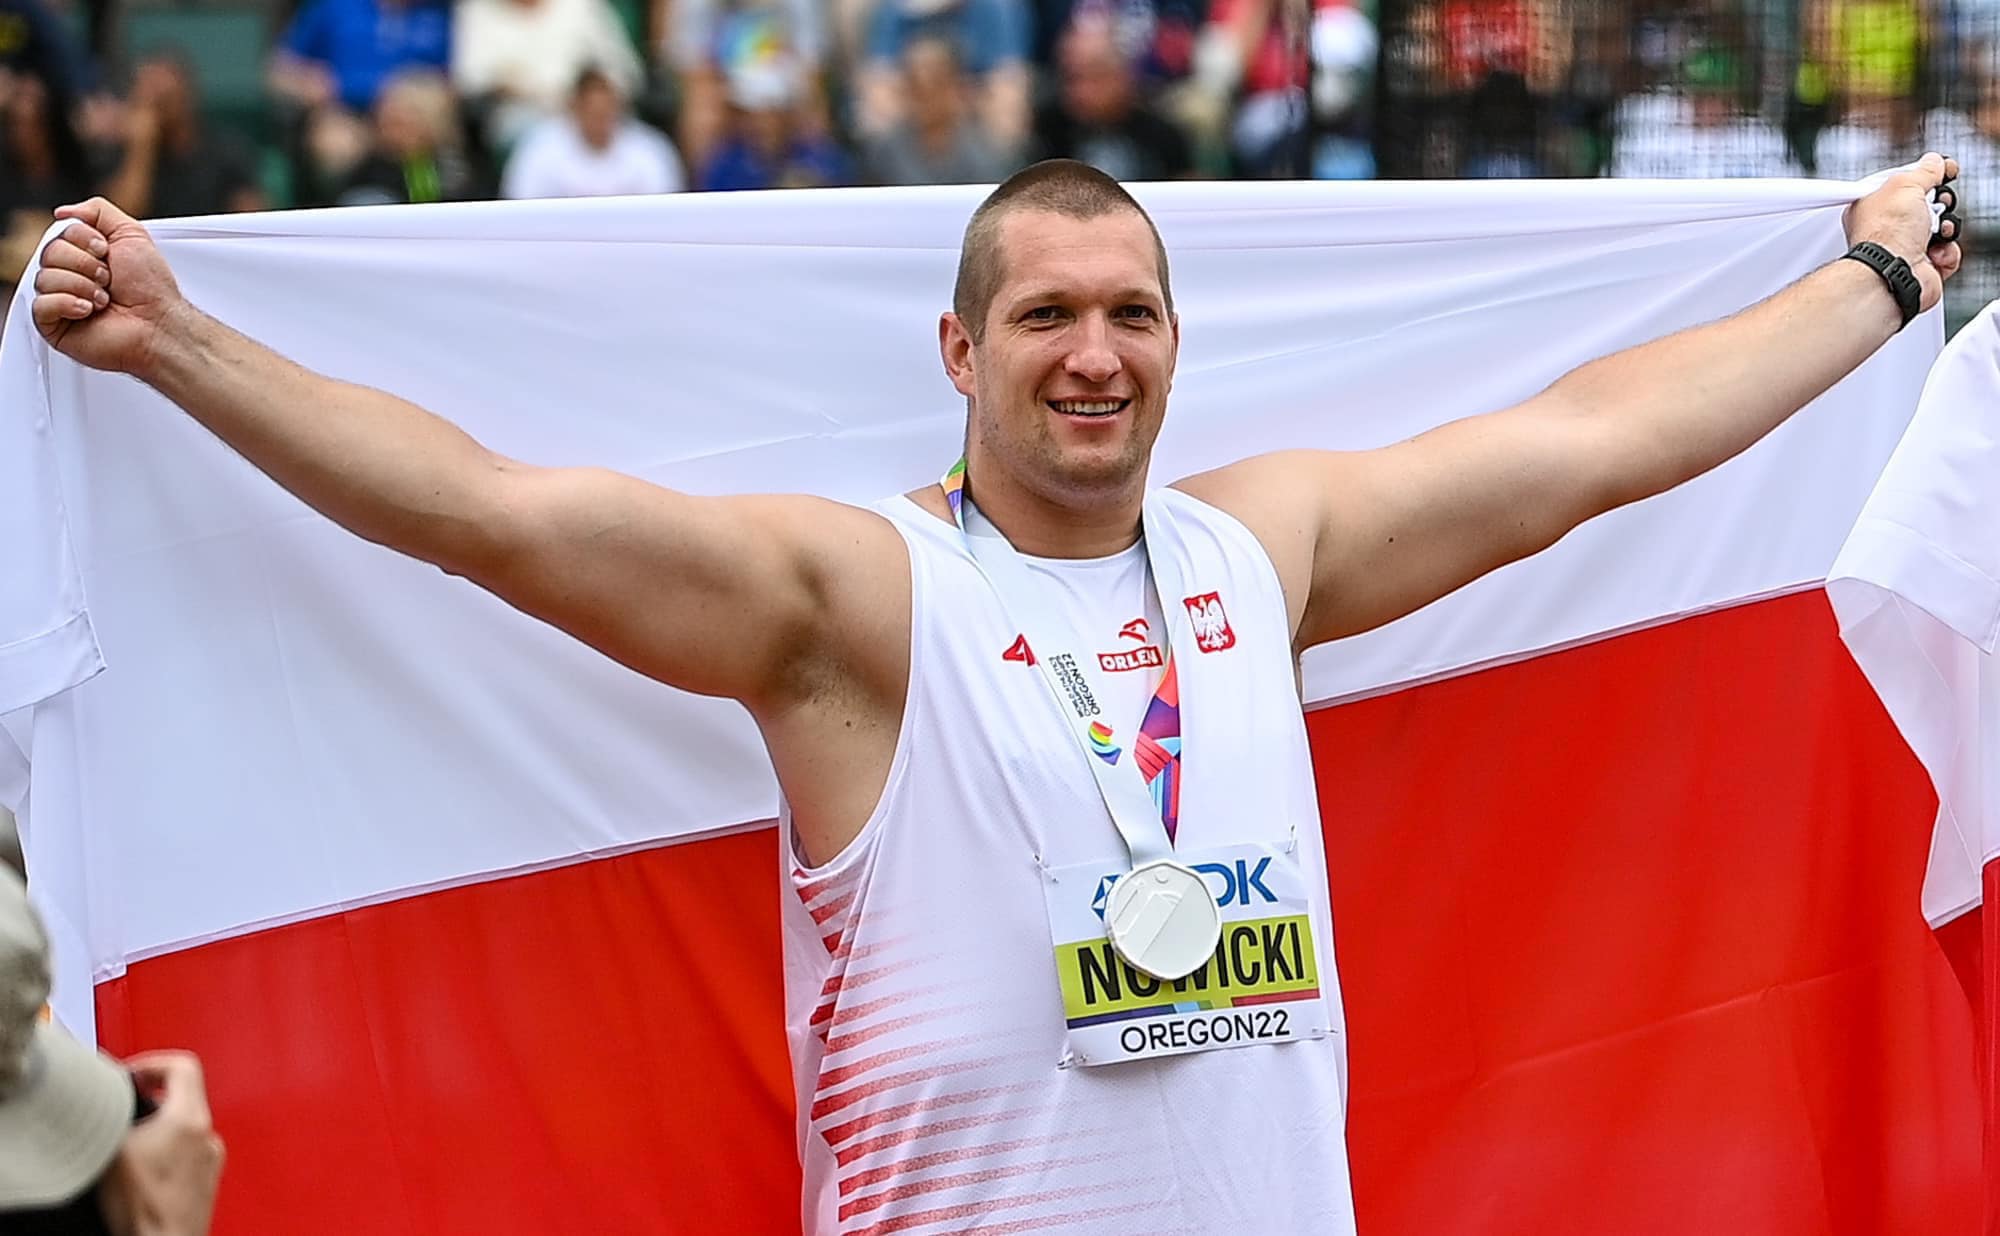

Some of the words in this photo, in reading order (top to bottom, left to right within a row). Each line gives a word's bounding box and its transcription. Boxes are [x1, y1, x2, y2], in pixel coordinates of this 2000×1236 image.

[1062, 653, 1076, 667] 22
[1101, 649, 1159, 670] ORLEN
[1070, 668, 1101, 715] OREGON
[1186, 857, 1279, 907] DK
[1121, 1009, 1290, 1053] OREGON22
